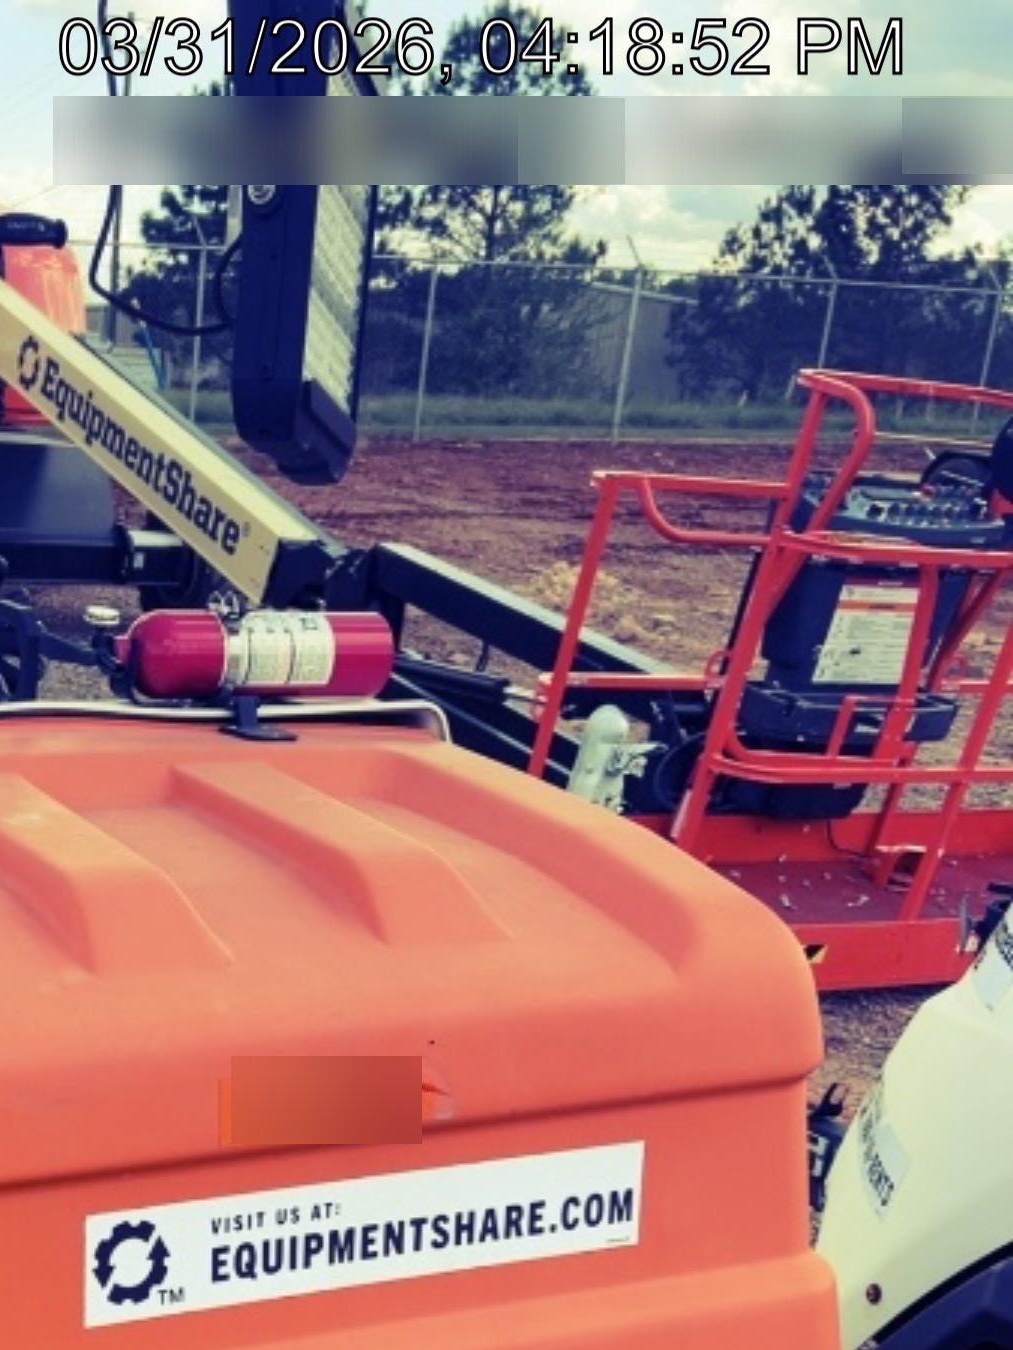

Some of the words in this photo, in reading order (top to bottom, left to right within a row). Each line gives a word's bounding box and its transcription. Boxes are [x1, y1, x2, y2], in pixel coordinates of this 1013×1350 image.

[41, 356, 240, 556] EquipmentShare
[210, 1186, 634, 1284] EQUIPMENTSHARE.COM
[211, 1211, 265, 1235] VISIT
[275, 1206, 301, 1225] US
[309, 1202, 342, 1221] AT:
